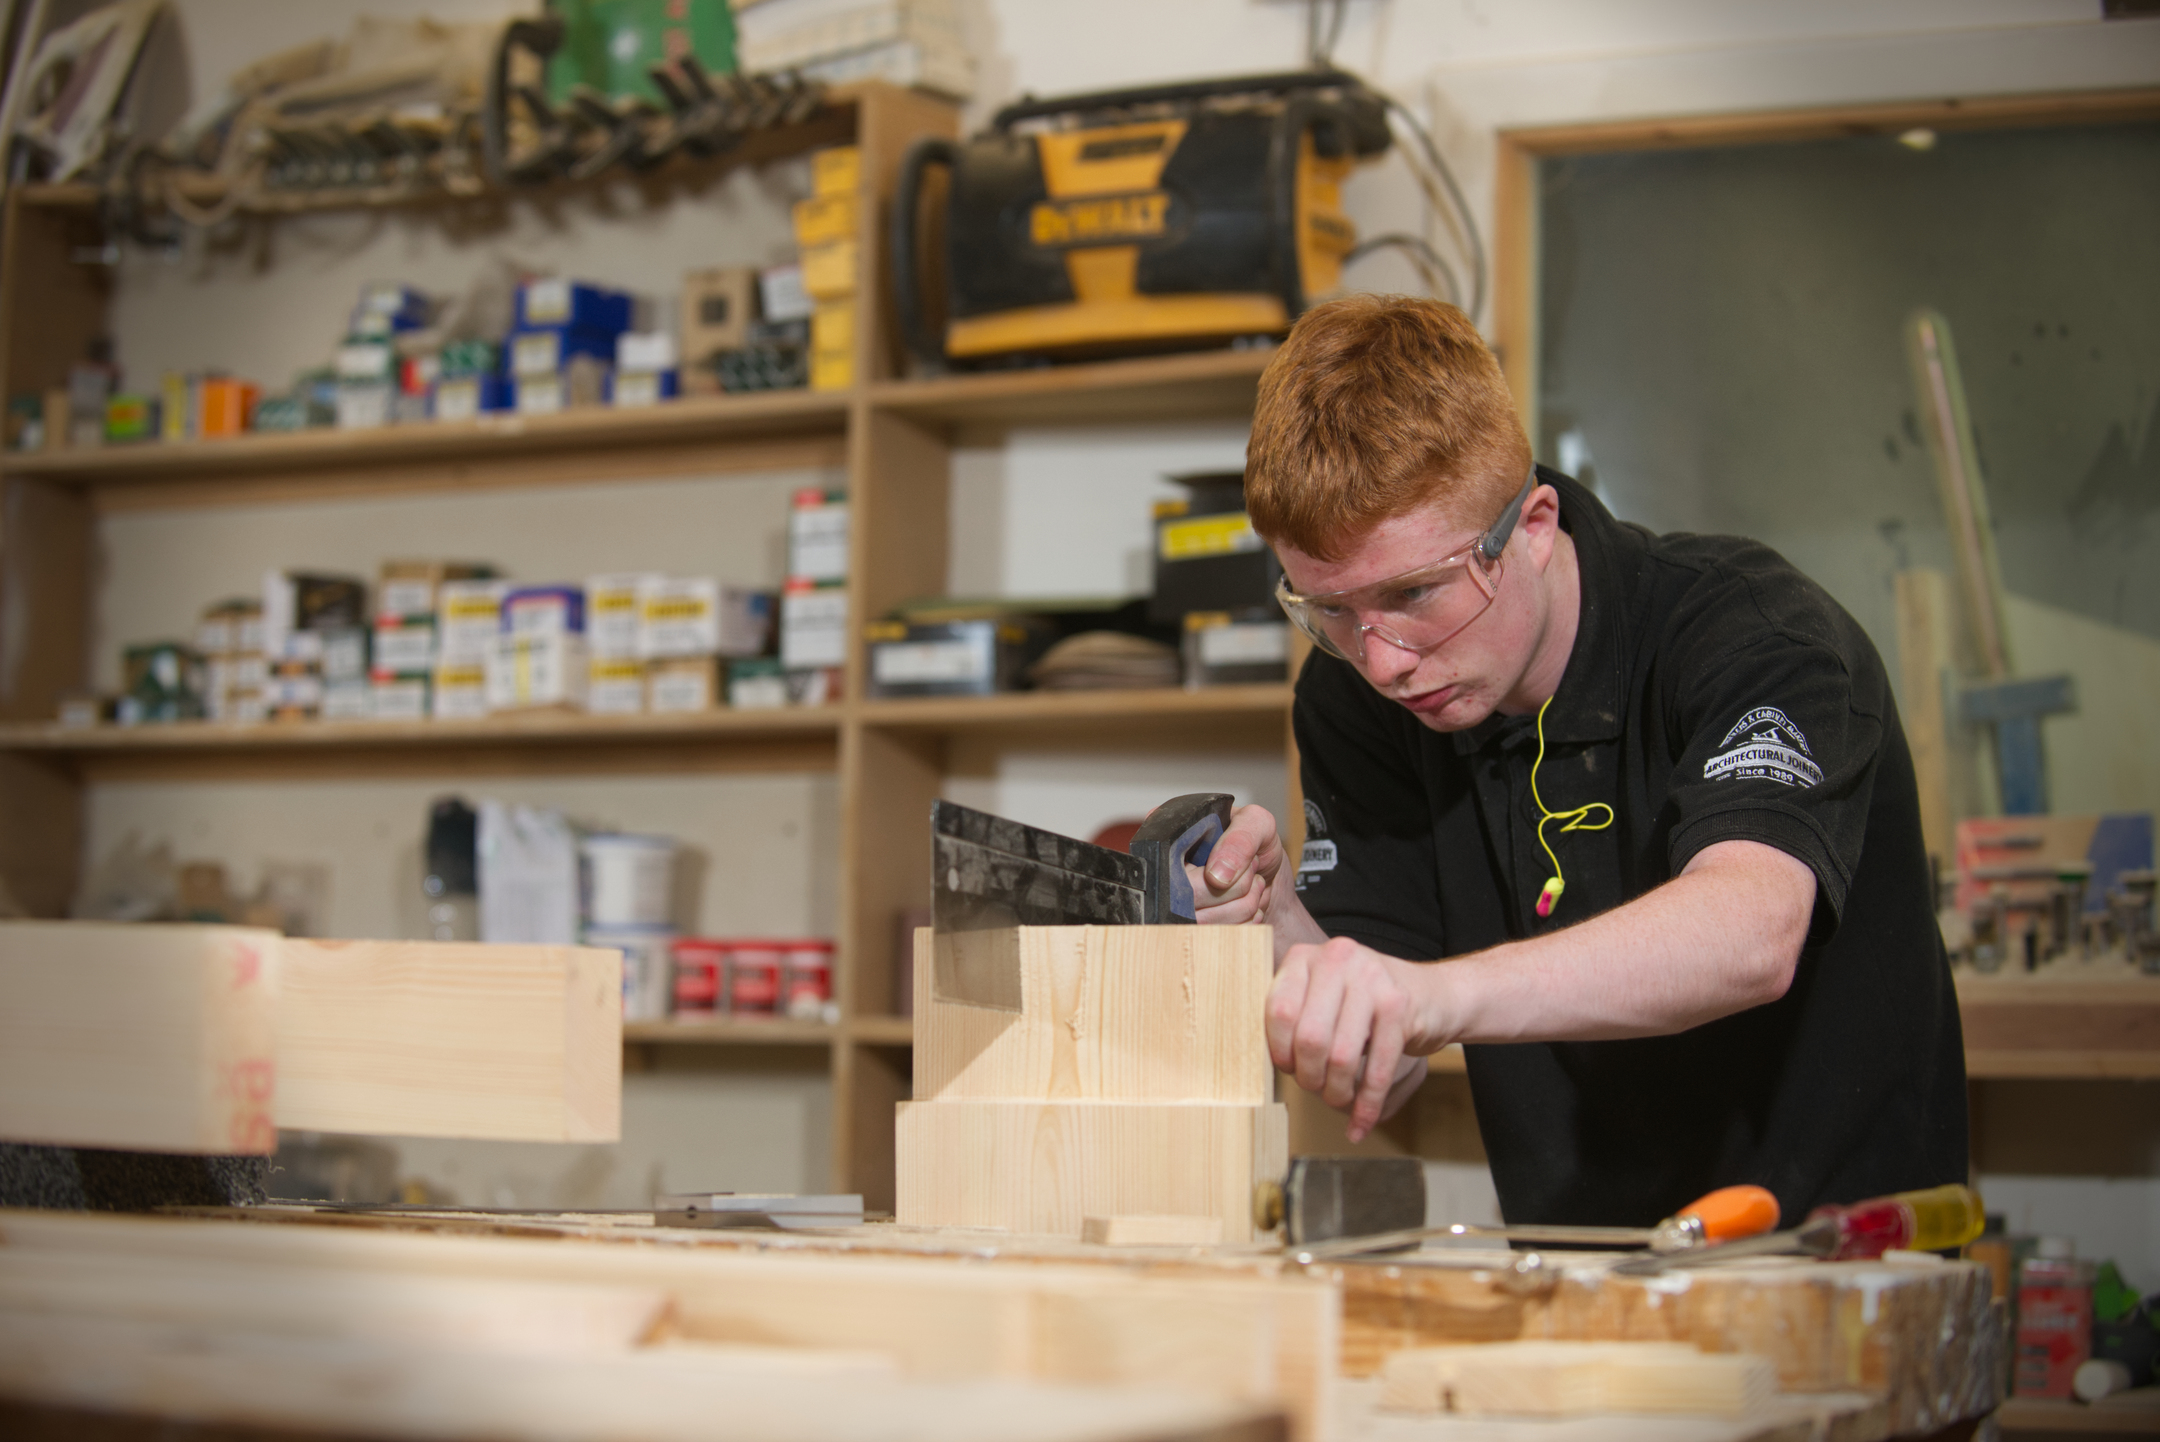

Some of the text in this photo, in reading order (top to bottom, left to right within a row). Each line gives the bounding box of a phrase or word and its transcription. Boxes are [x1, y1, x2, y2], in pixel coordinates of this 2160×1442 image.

[1705, 749, 1785, 775] ARCHITECTURAL
[1735, 767, 1794, 782] Since 1989
